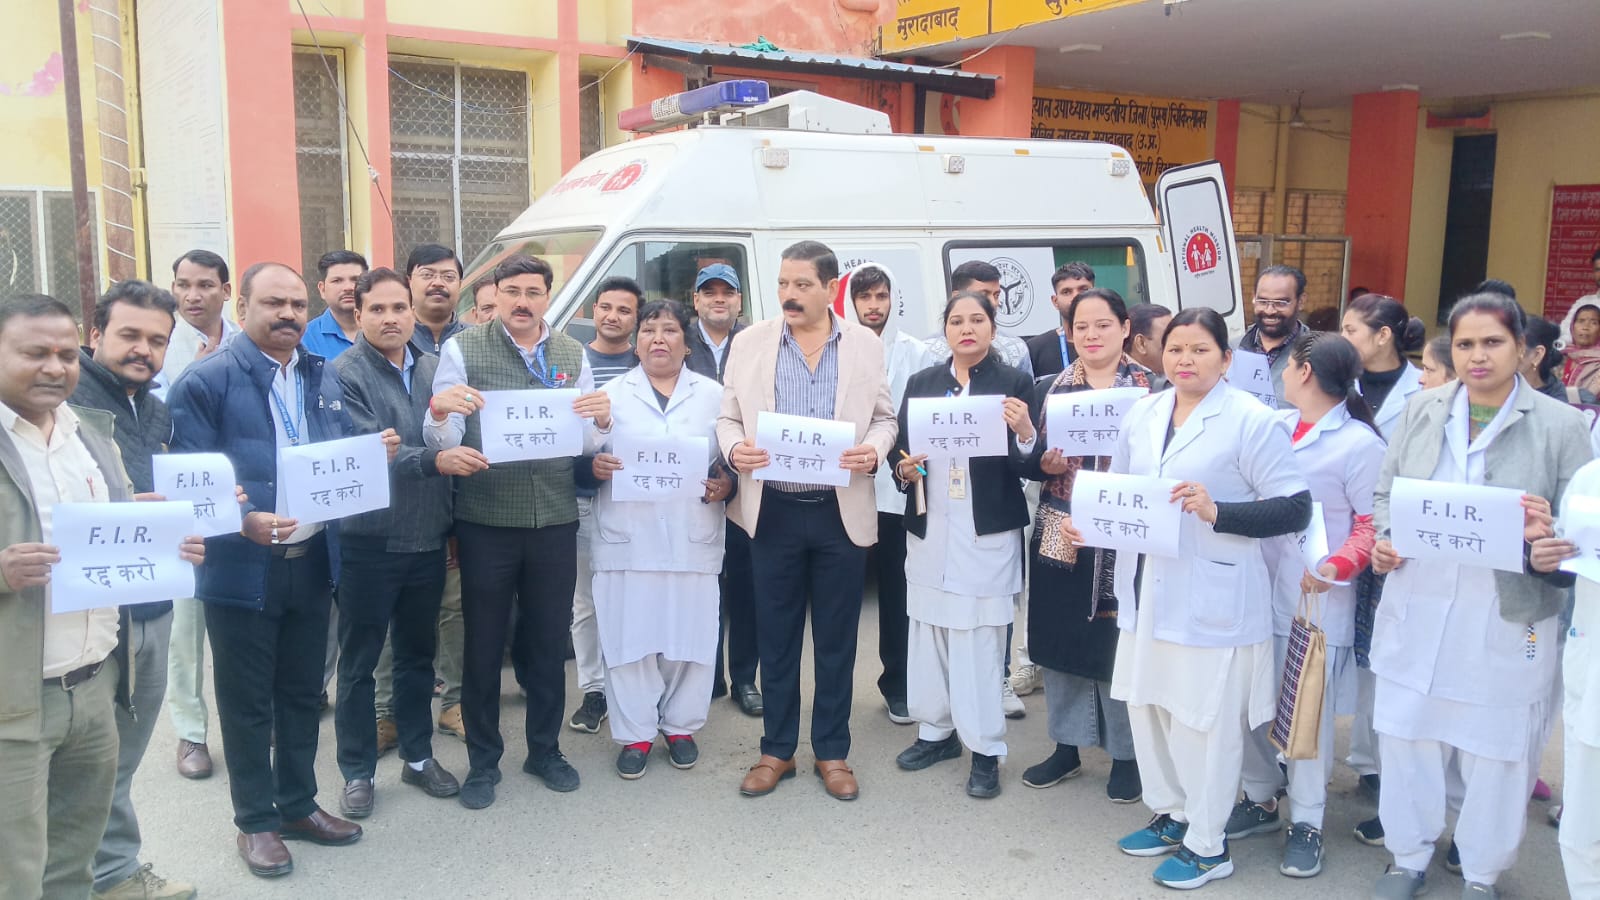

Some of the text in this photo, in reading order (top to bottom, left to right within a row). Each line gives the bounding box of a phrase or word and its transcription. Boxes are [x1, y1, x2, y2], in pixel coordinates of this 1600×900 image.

[896, 6, 961, 40] मुरादाबाद
[1053, 98, 1092, 121] उपाध्याय
[528, 427, 557, 445] करो
[952, 432, 981, 447] करो
[1092, 425, 1120, 441] करो
[797, 454, 826, 471] करो
[335, 480, 364, 501] करो
[655, 472, 683, 489] करो
[1118, 518, 1150, 540] करो
[1447, 531, 1486, 554] करो
[116, 556, 156, 583] करो
